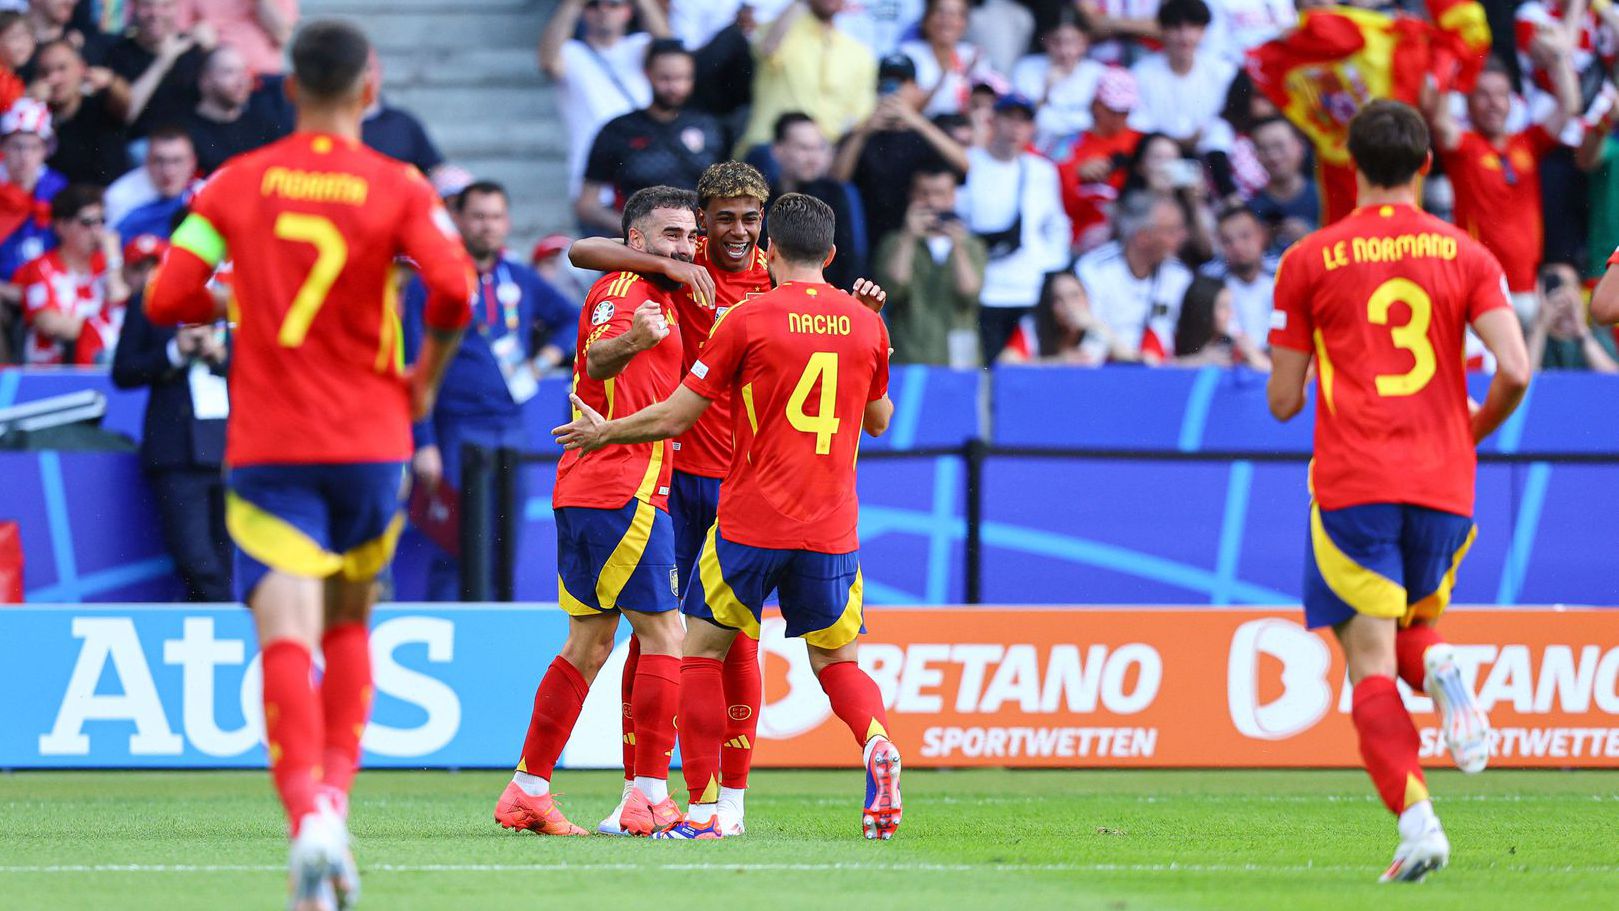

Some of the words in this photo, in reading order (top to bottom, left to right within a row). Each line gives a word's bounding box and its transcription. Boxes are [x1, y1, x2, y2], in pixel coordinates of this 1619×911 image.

[273, 211, 349, 348] 7
[1322, 241, 1350, 271] LE
[1352, 233, 1457, 261] NORMAND
[788, 312, 851, 336] NACHO
[1367, 277, 1437, 397] 3
[785, 351, 840, 455] 4
[921, 727, 1157, 757] SPORTWETTEN
